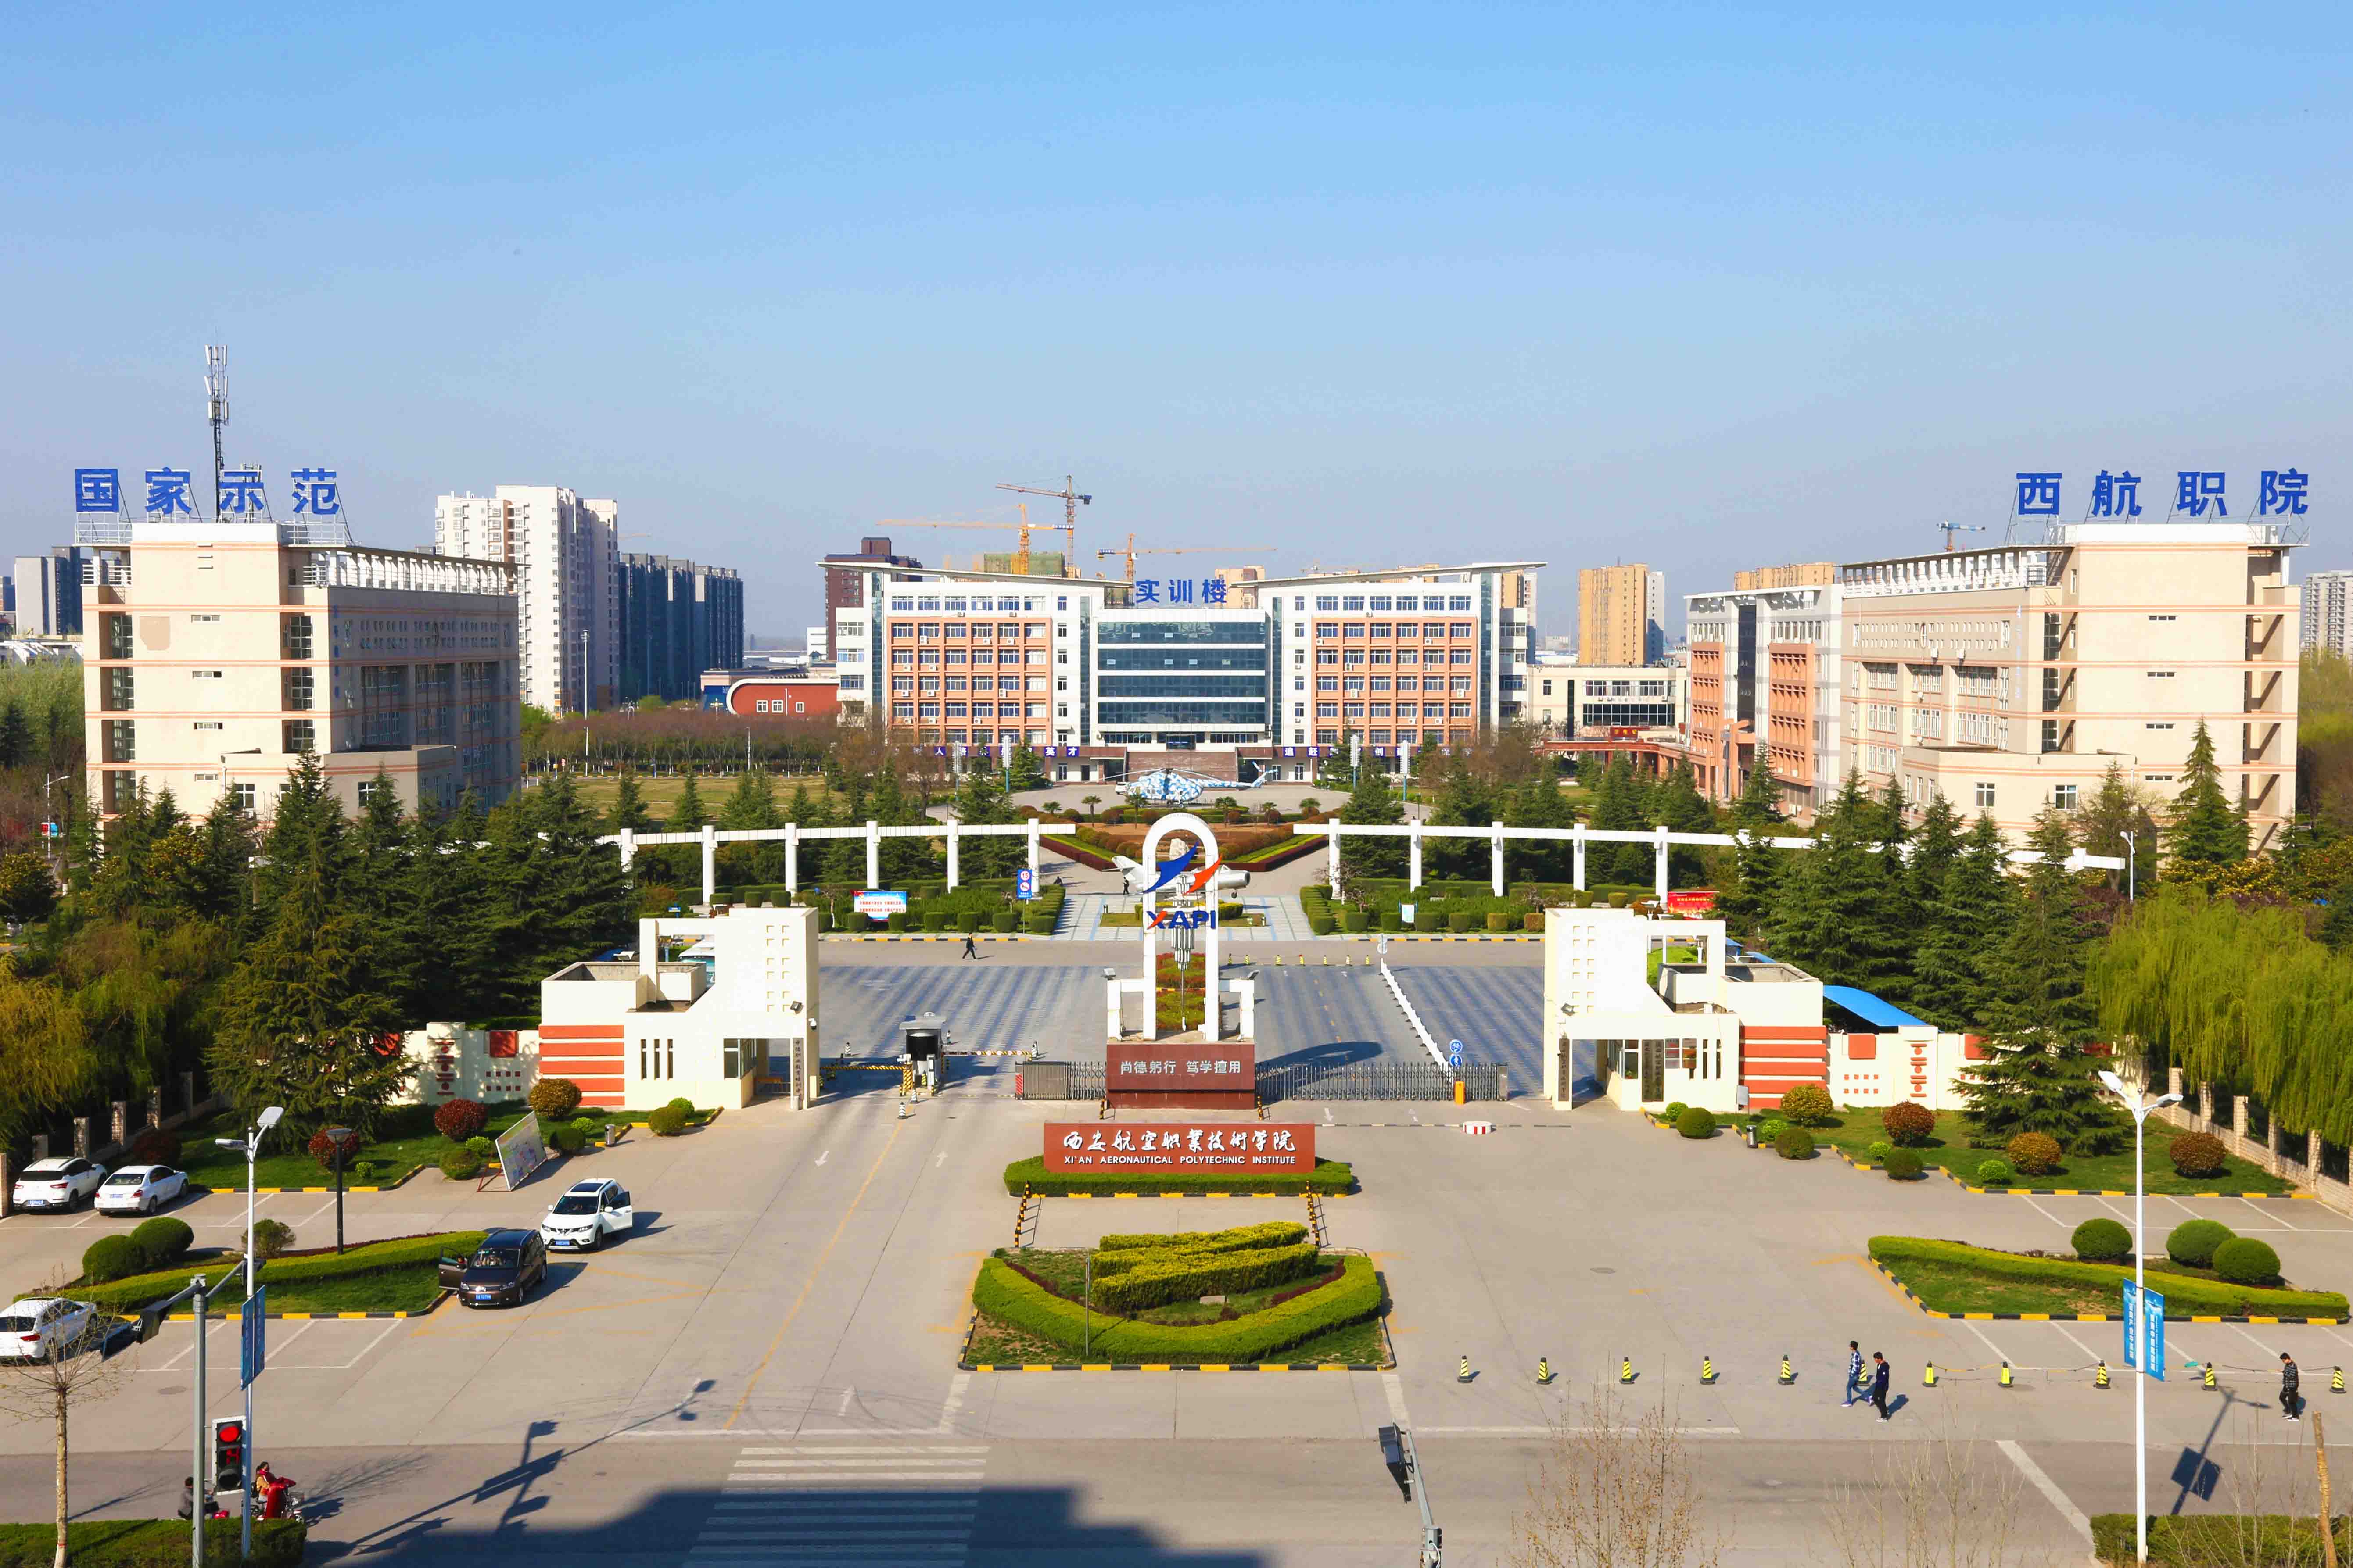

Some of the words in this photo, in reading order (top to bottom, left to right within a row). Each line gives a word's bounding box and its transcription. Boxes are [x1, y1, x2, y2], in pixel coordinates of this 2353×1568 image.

[75, 467, 340, 515] 国家示范
[2016, 468, 2308, 516] 西航职院
[1136, 579, 1227, 603] 实训楼
[1146, 910, 1216, 930] XAPI
[1120, 1060, 1176, 1074] 尚德躬行
[1186, 1060, 1241, 1074] 笃学擅用
[1100, 1156, 1173, 1164] AERONAUTICAL
[1180, 1156, 1246, 1164] POLYTECHNIC
[1253, 1156, 1295, 1164] INSTITUTE
